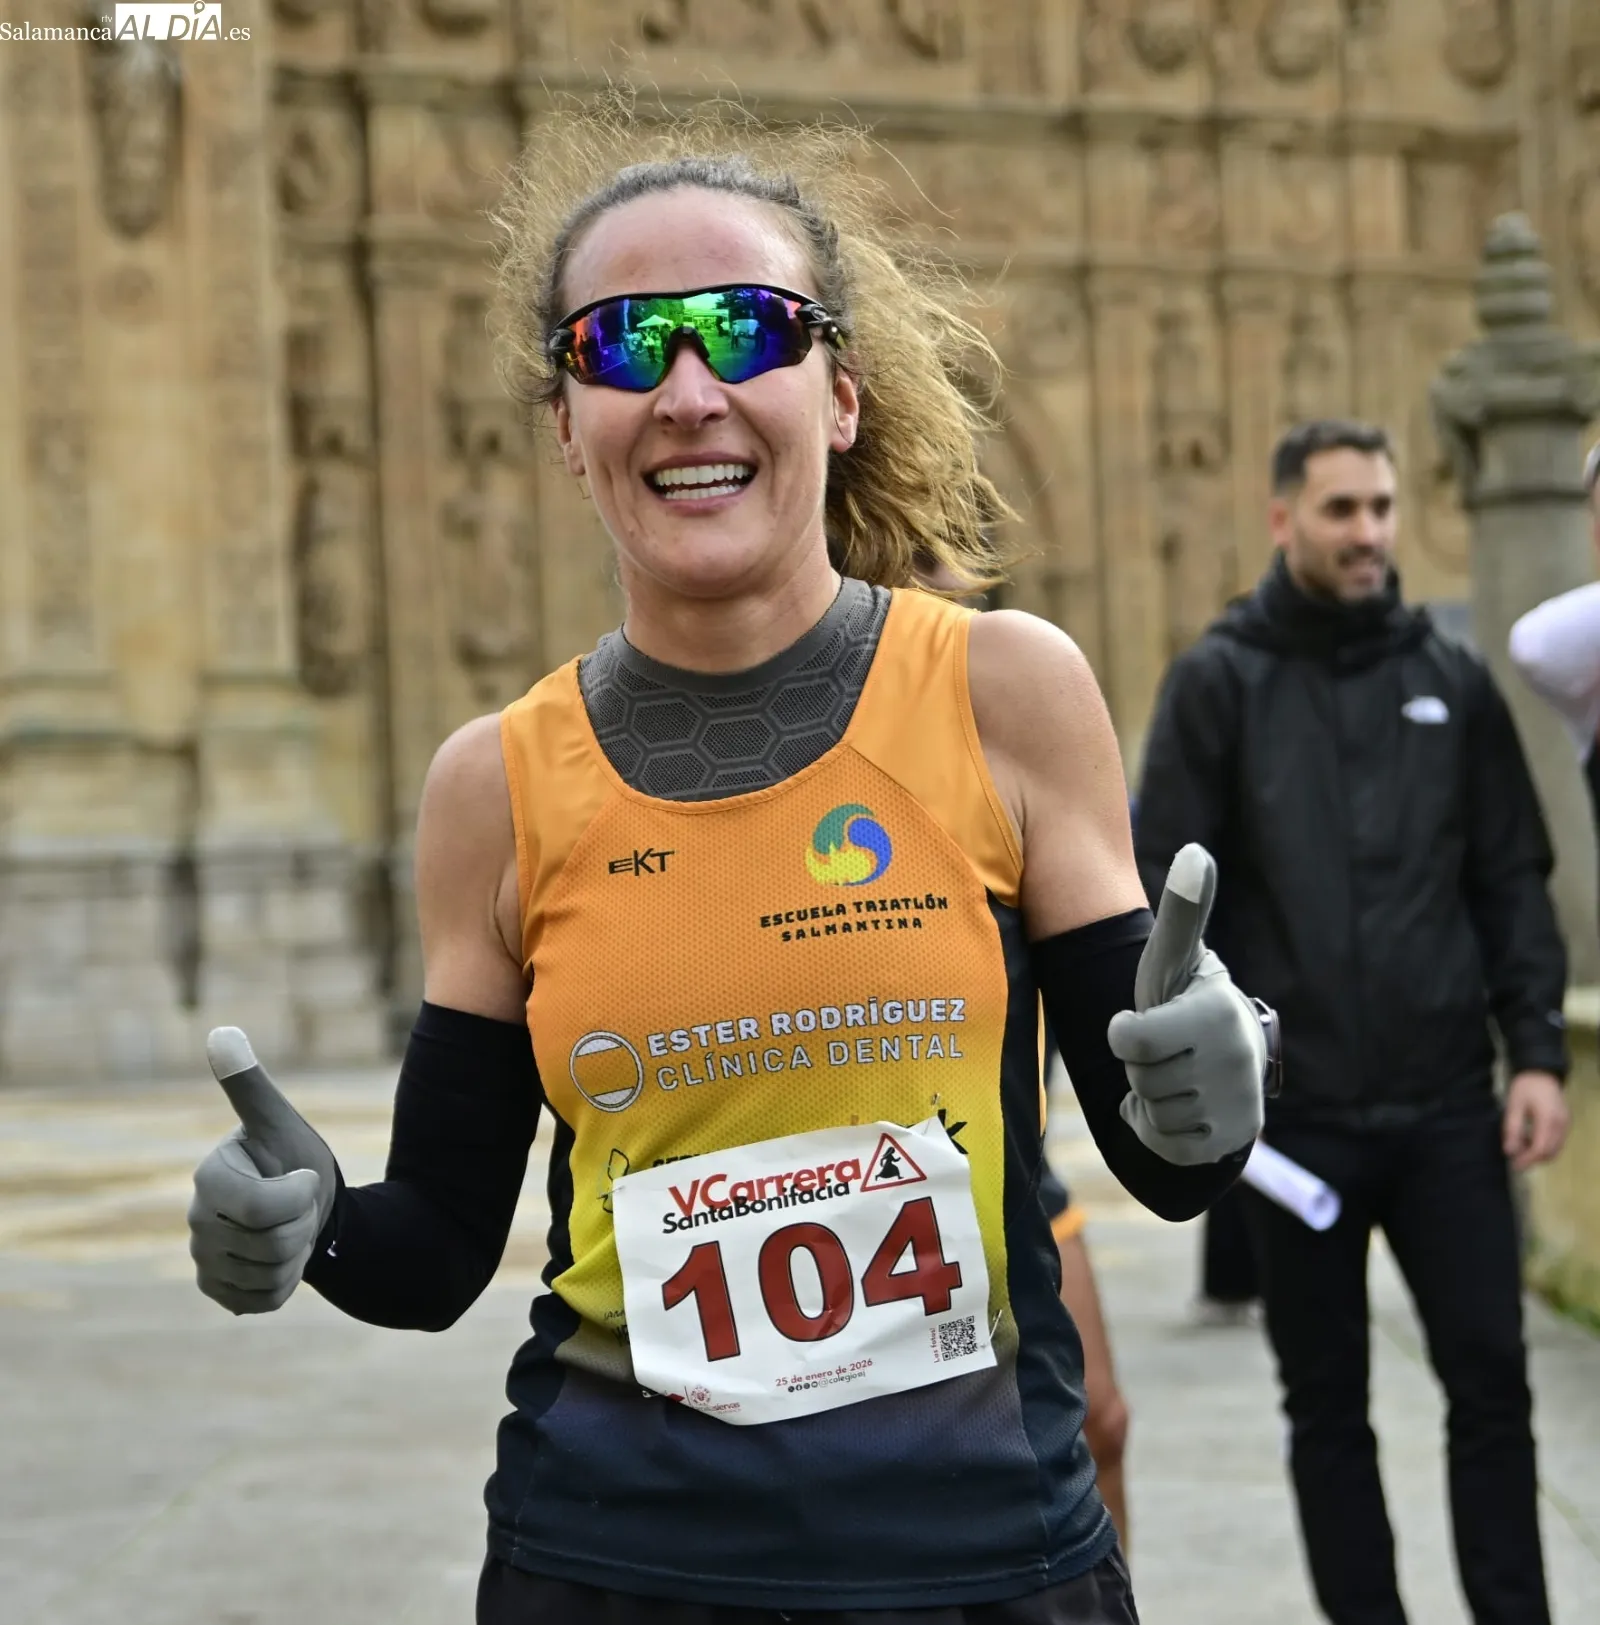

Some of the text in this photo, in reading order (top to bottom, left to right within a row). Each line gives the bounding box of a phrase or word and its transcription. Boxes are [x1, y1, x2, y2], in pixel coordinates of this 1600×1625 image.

[760, 893, 948, 928] ESCUELA TRIATLÓN
[781, 917, 923, 942] SALMANTINA
[646, 996, 966, 1057] ESTER RODRÍGUEZ
[656, 1032, 964, 1091] CLÍNICA DENTAL
[661, 1196, 963, 1362] 104
[775, 1358, 873, 1387] 25 de enero de 2026
